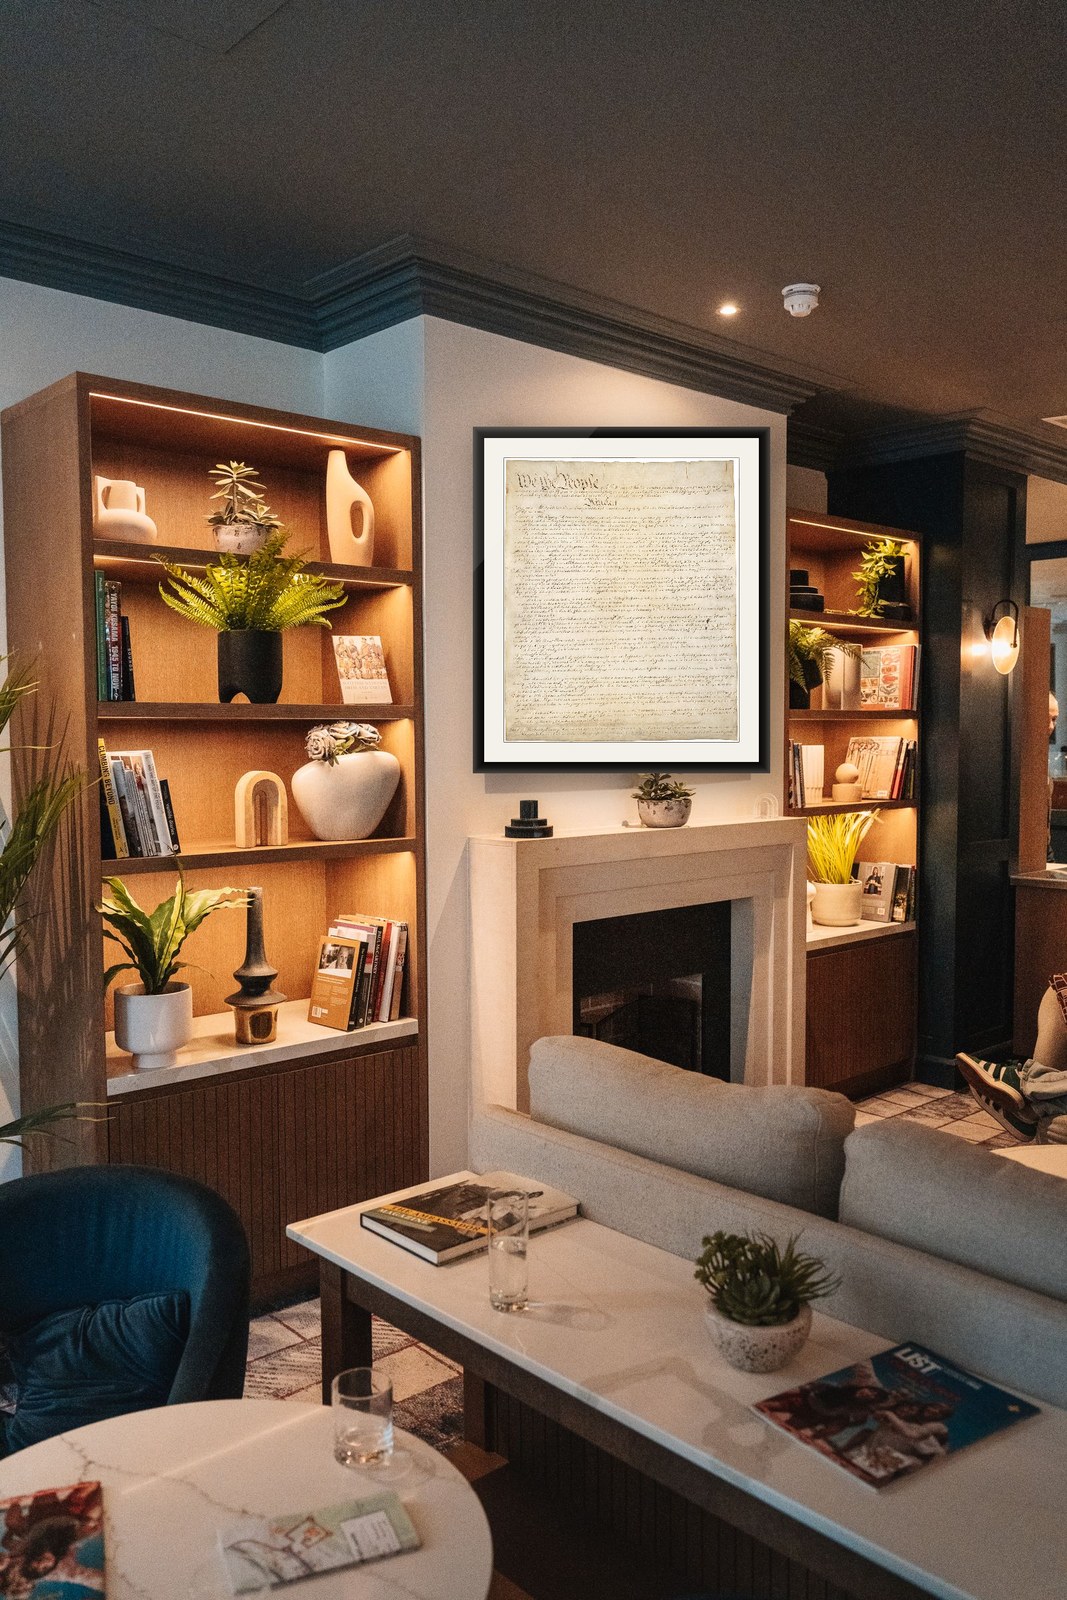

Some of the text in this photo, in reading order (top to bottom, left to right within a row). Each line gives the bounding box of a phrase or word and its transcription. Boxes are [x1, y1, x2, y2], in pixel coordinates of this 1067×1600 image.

[516, 472, 536, 488] We
[556, 471, 599, 490] People
[110, 613, 119, 642] KUSAMA
[111, 646, 119, 662] 1945
[112, 664, 119, 672] TO
[112, 673, 120, 690] NOW
[98, 745, 115, 805] CLIMBING BEYOND
